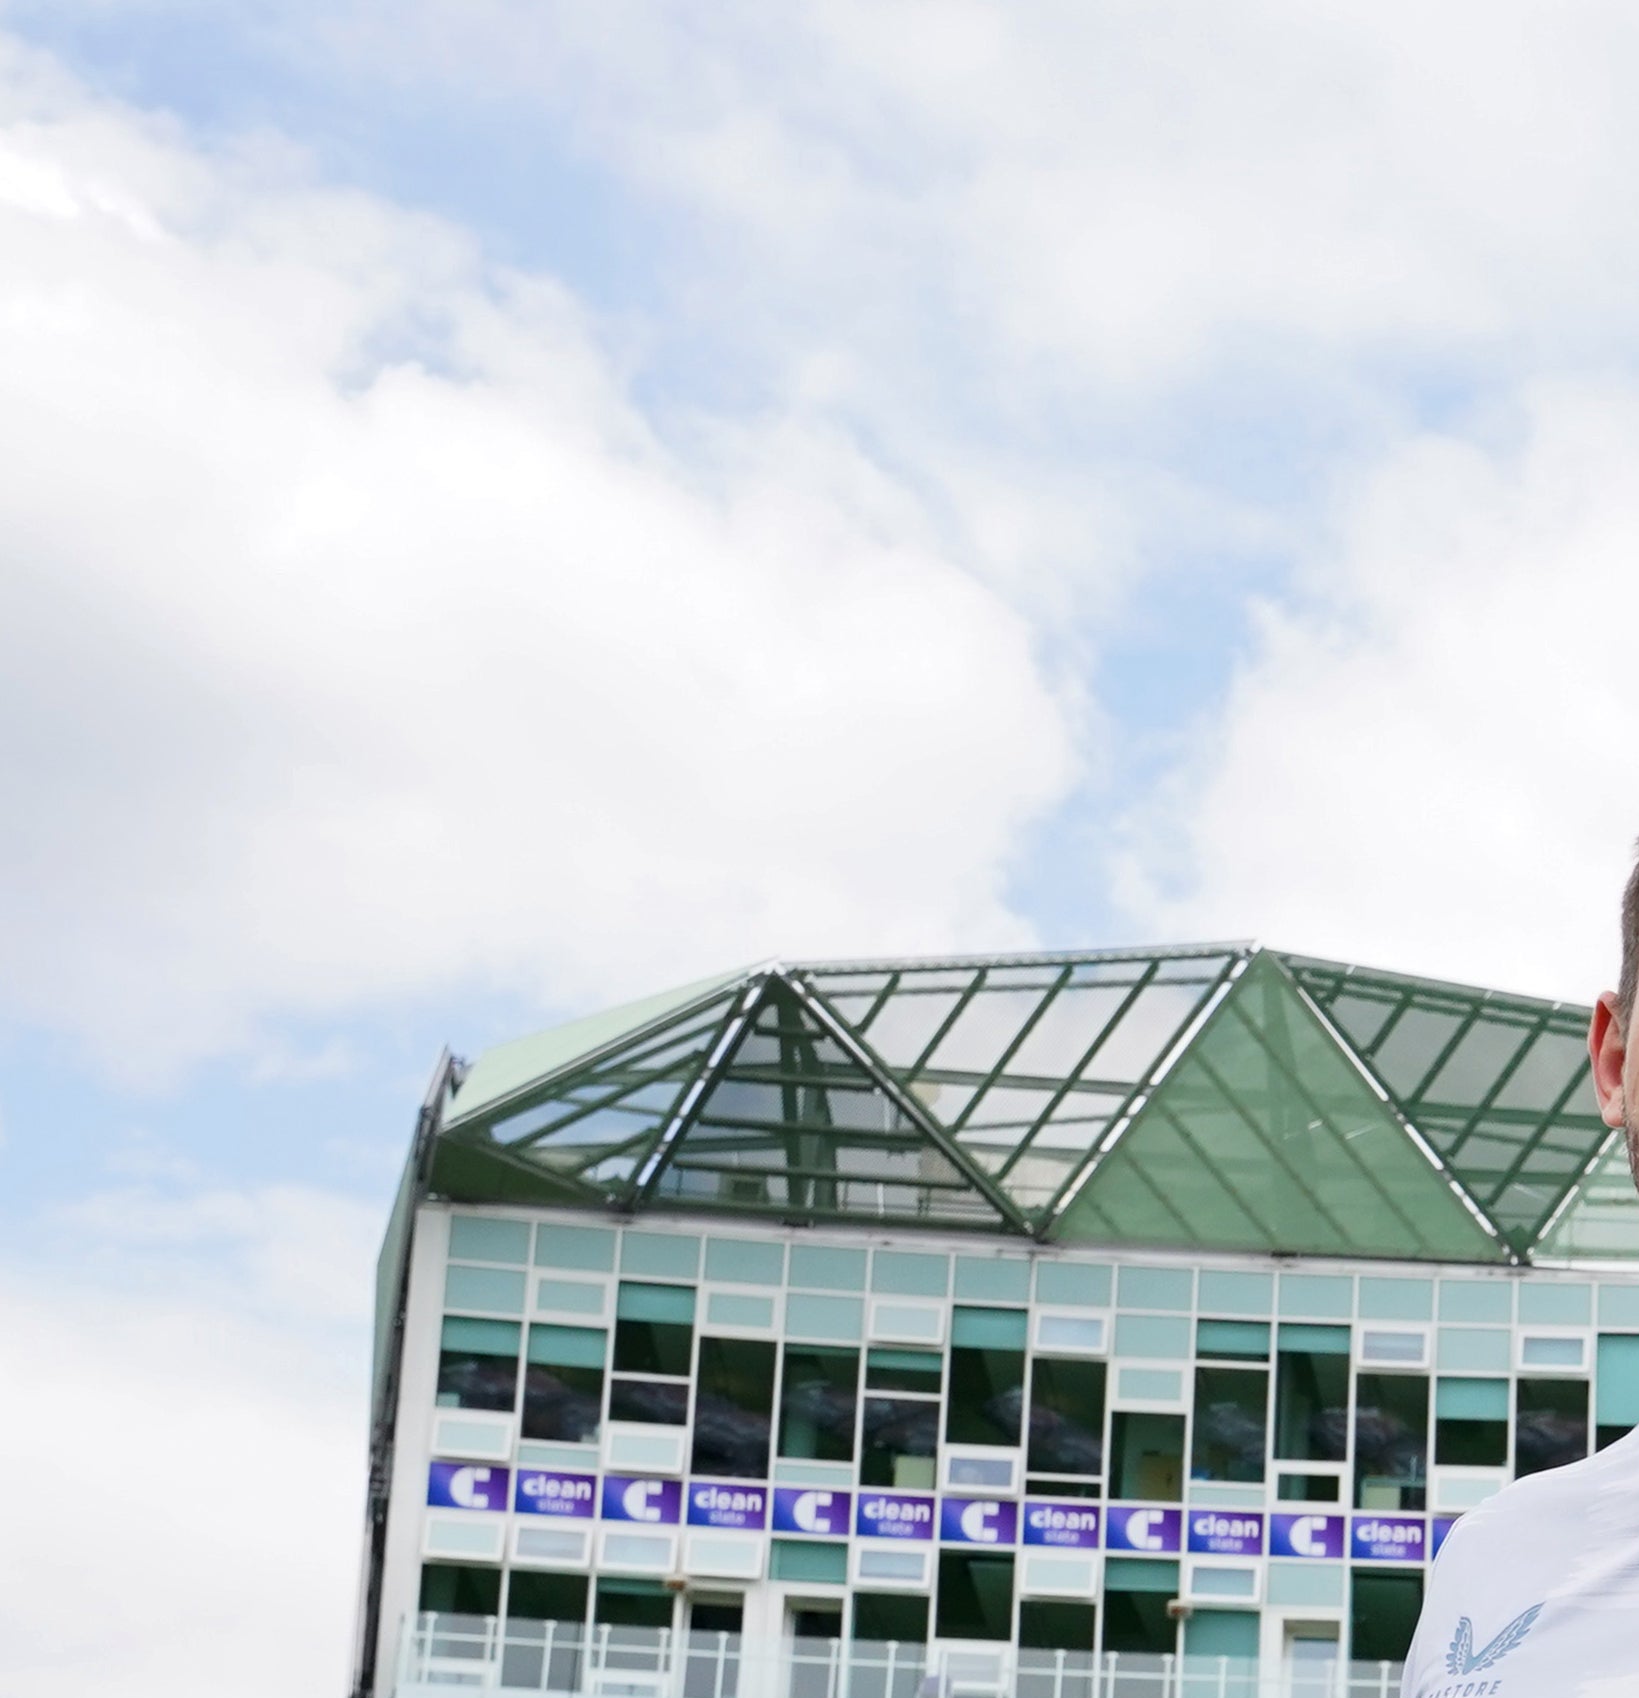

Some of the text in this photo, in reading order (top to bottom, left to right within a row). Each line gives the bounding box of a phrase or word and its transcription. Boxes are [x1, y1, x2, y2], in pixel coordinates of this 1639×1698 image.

[522, 1474, 592, 1501] clean
[694, 1487, 763, 1513] clean
[862, 1497, 931, 1523] clean
[1029, 1505, 1097, 1531] clean
[1193, 1514, 1260, 1539] clean
[1356, 1521, 1423, 1545] clean
